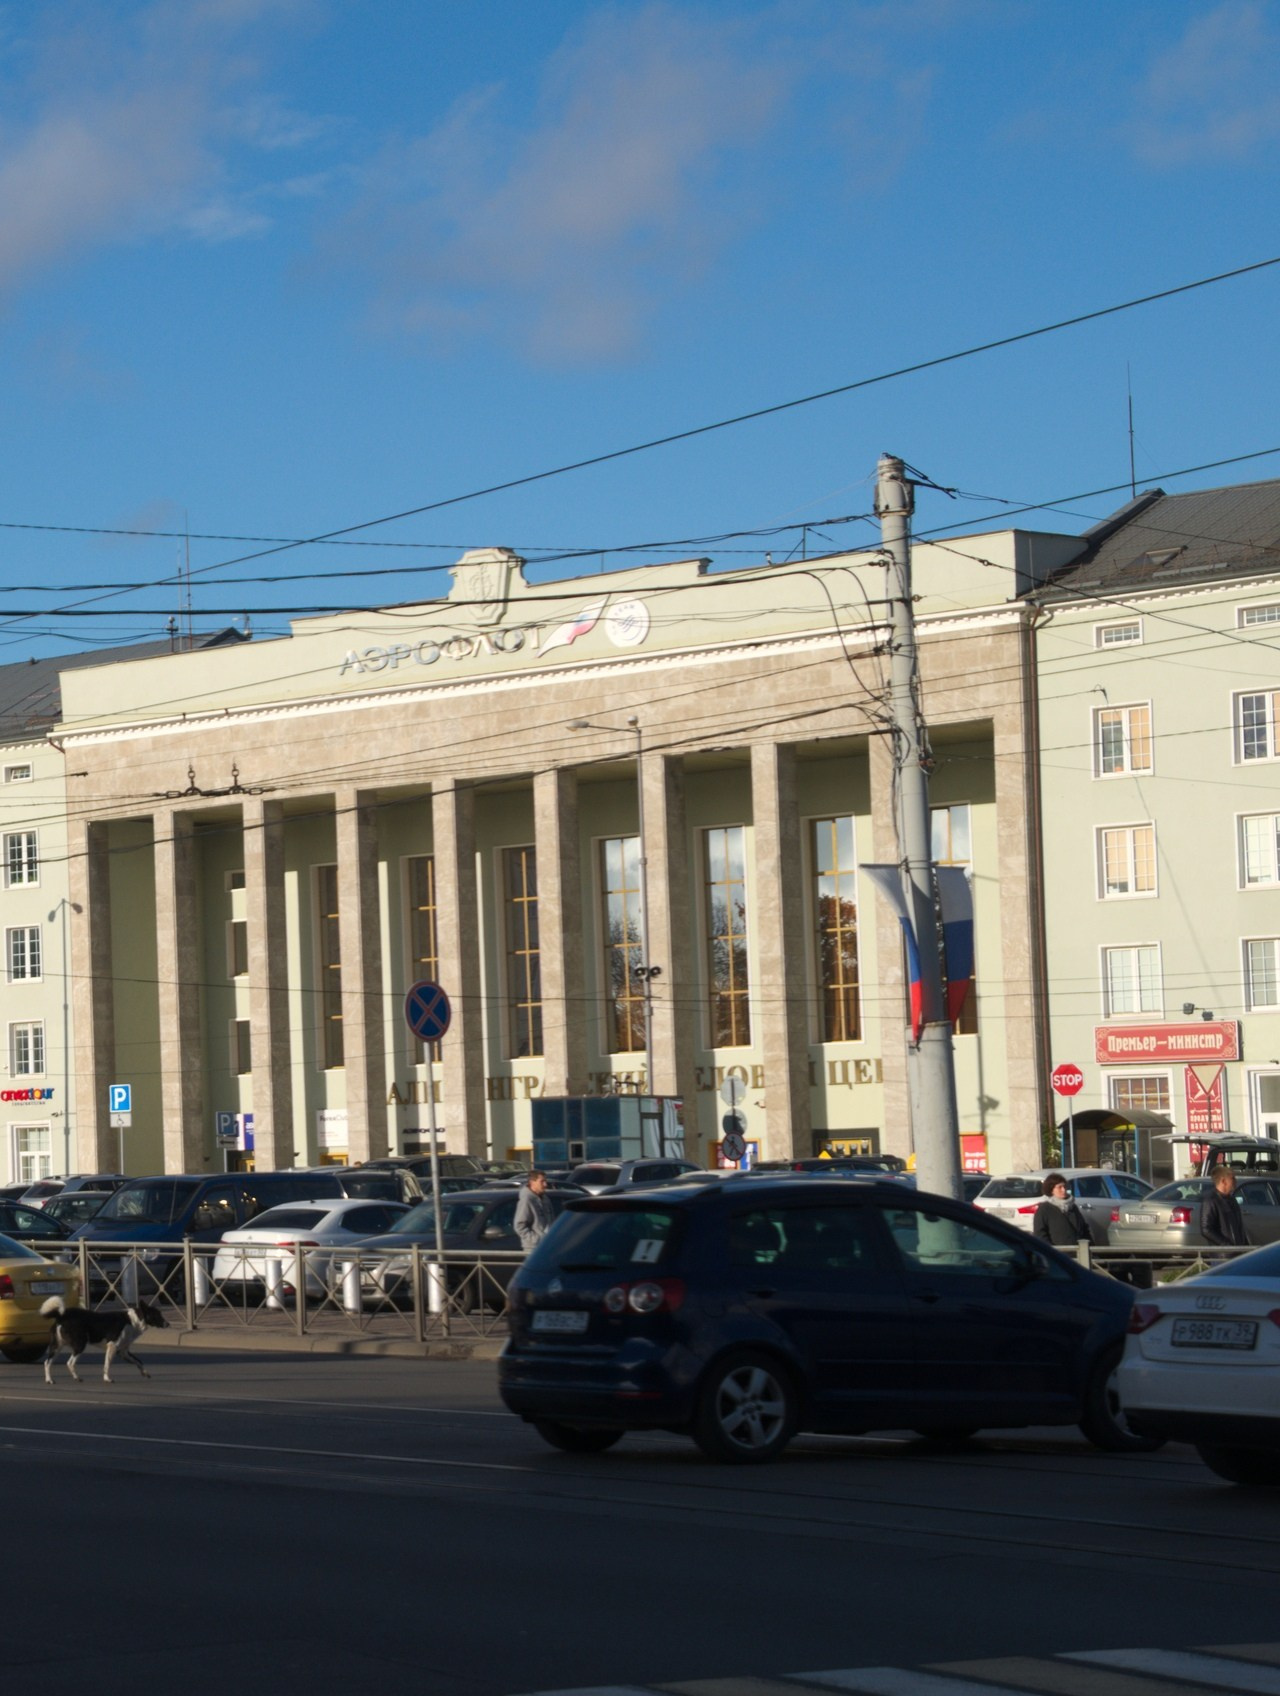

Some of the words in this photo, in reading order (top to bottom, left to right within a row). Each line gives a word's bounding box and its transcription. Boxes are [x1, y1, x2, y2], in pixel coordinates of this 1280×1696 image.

[339, 624, 546, 676] АЭРОФЛОТ
[1053, 1074, 1082, 1086] STOP
[114, 1088, 126, 1109] P
[220, 1114, 231, 1132] P
